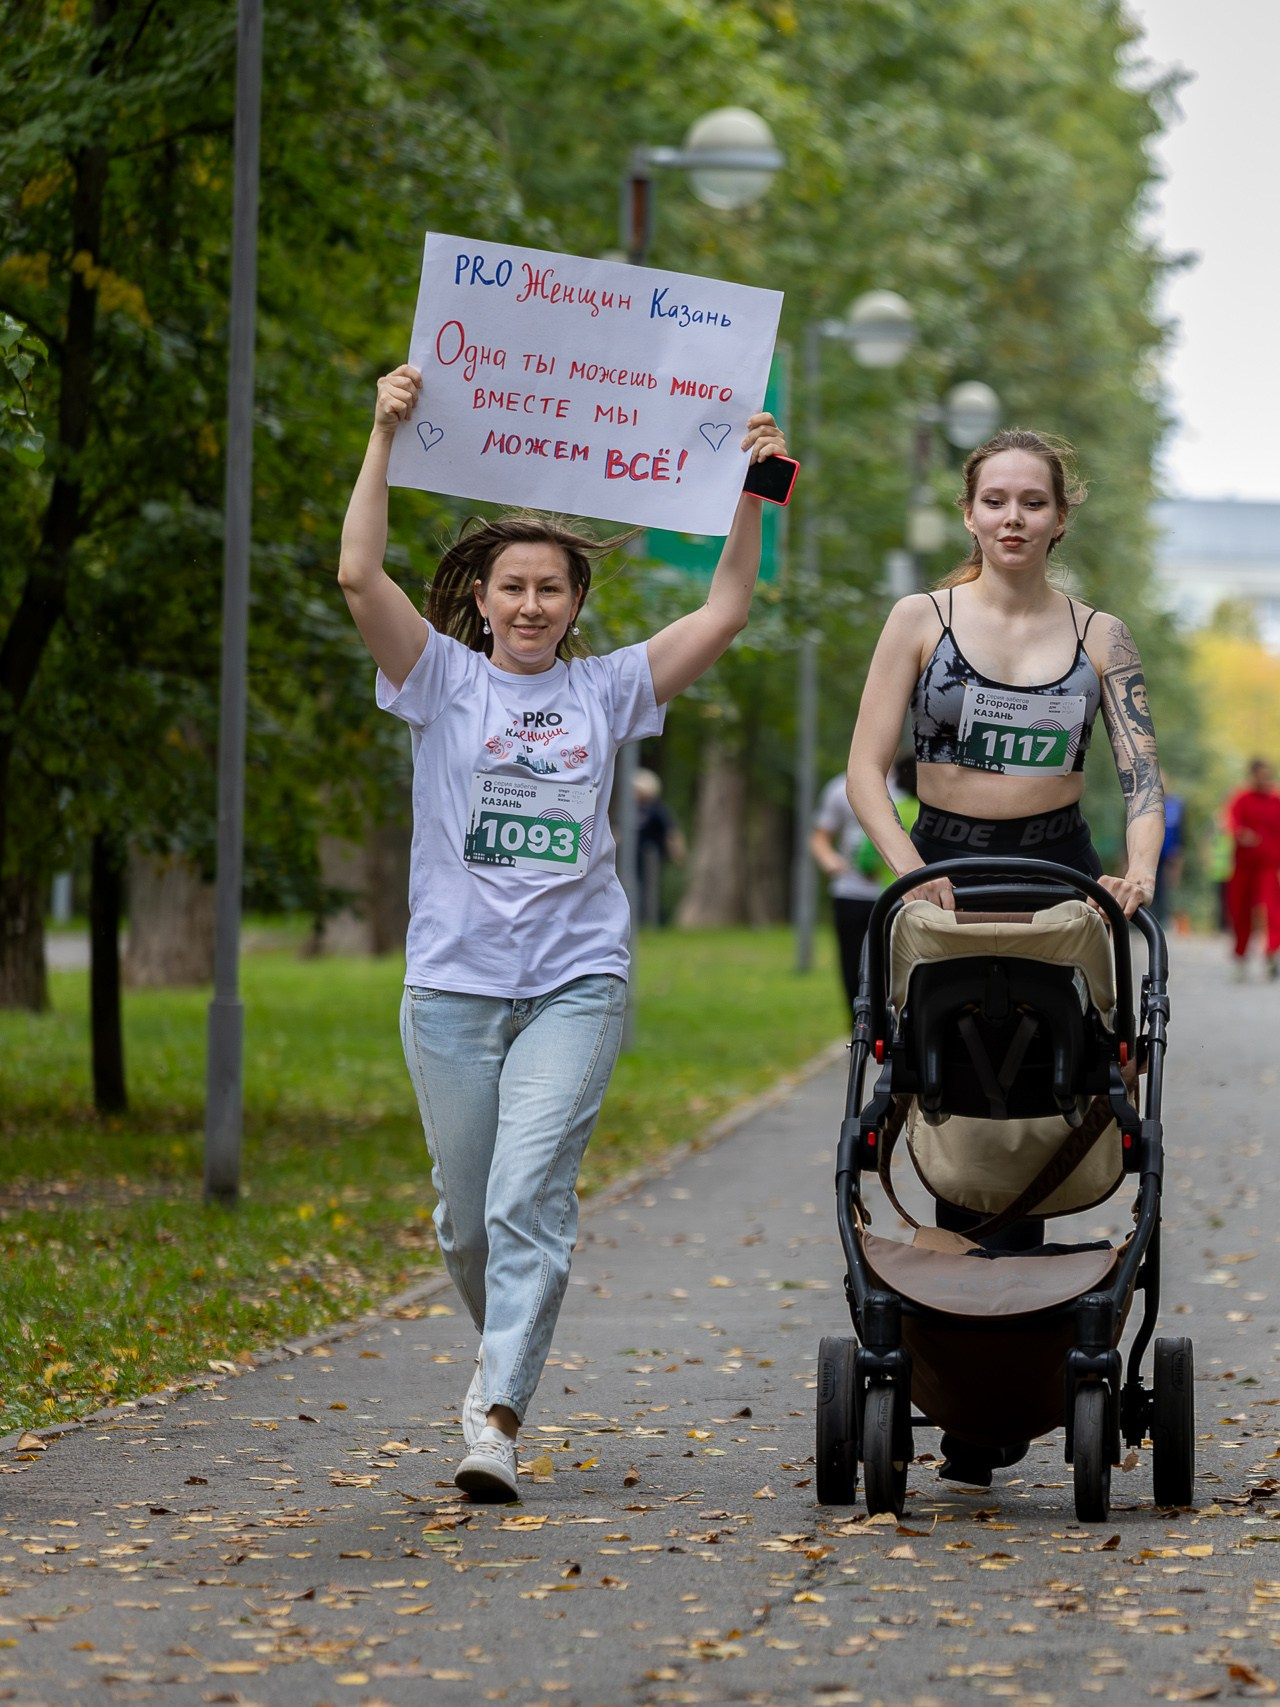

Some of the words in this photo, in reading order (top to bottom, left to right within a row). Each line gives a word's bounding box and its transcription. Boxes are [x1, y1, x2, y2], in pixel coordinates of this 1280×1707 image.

[455, 254, 512, 287] PRO
[517, 263, 631, 316] Женщин
[650, 287, 731, 328] Казань
[436, 320, 507, 382] Одна
[569, 361, 657, 389] можешь
[473, 388, 571, 419] ВМЕСТЕ
[594, 404, 638, 427] МЫ
[480, 429, 589, 461] МОЖЕМ
[604, 448, 690, 484] ВСЁ!
[973, 708, 1013, 720] КАЗАНЬ
[975, 693, 985, 704] 8
[985, 699, 1028, 711] городов
[513, 720, 569, 746] енщин
[522, 711, 563, 728] PRO
[982, 730, 1057, 762] 1117
[481, 796, 522, 809] КАЗАНЬ
[483, 780, 493, 792] 8
[493, 786, 537, 798] городов
[482, 819, 575, 858] 1093
[917, 810, 996, 848] FIDE
